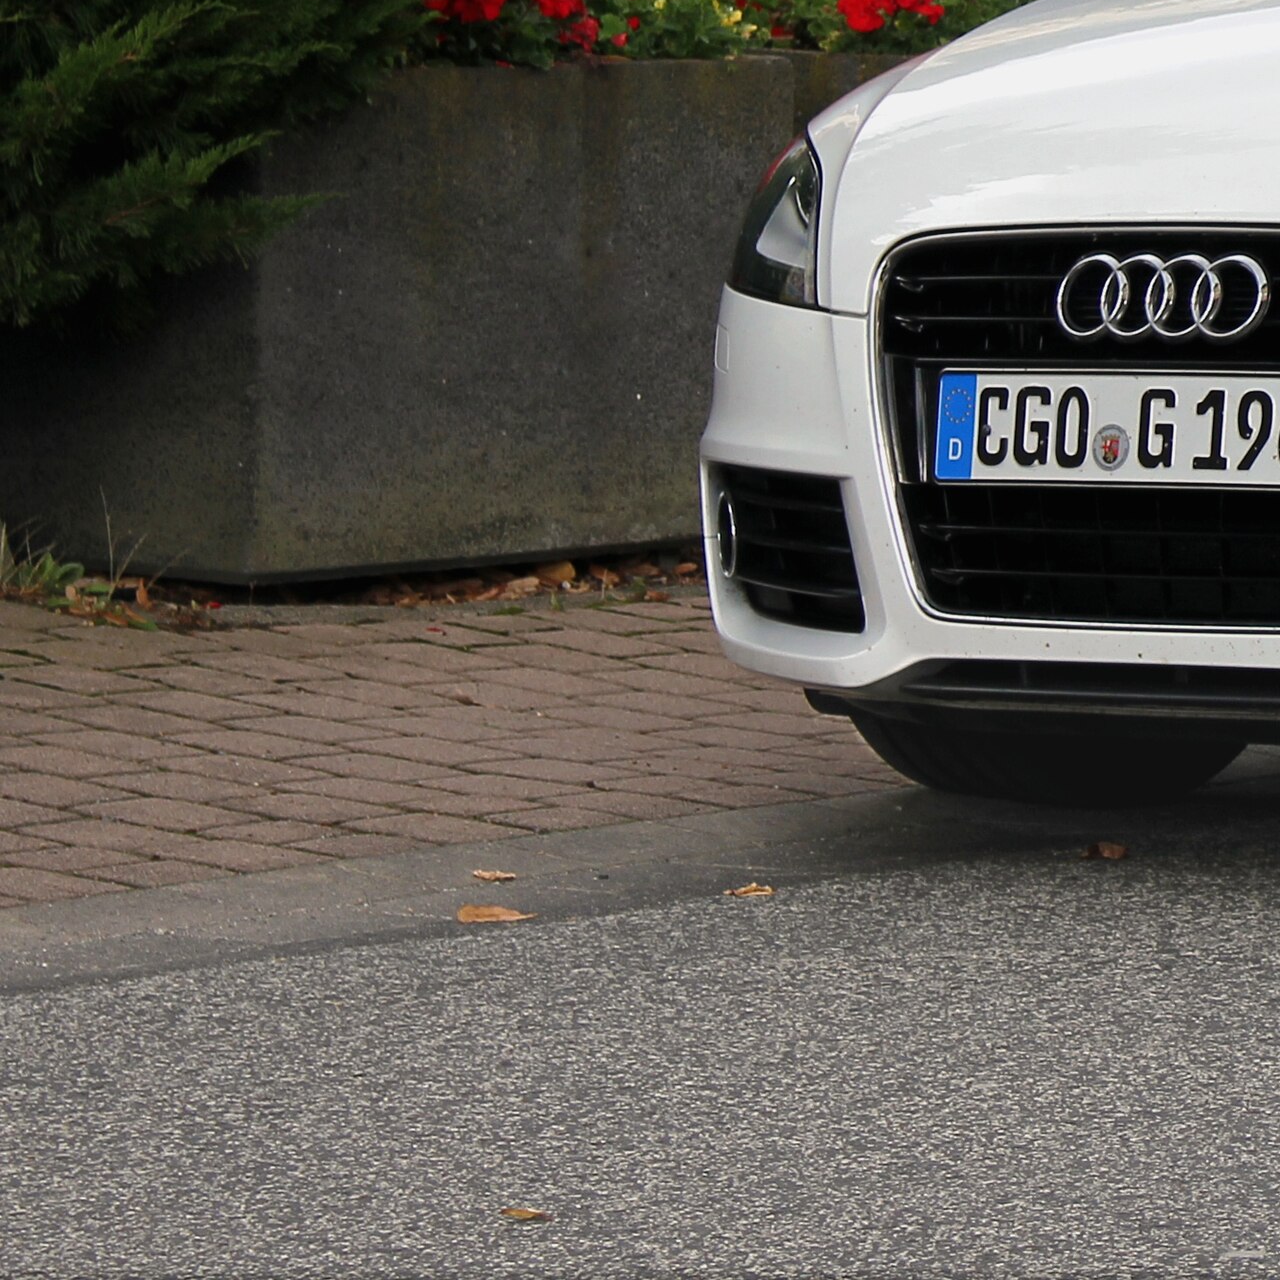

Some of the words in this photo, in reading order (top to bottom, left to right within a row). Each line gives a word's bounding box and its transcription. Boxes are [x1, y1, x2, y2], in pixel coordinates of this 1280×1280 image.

[948, 437, 962, 461] D
[977, 386, 1090, 468] CGO
[1137, 388, 1177, 469] G
